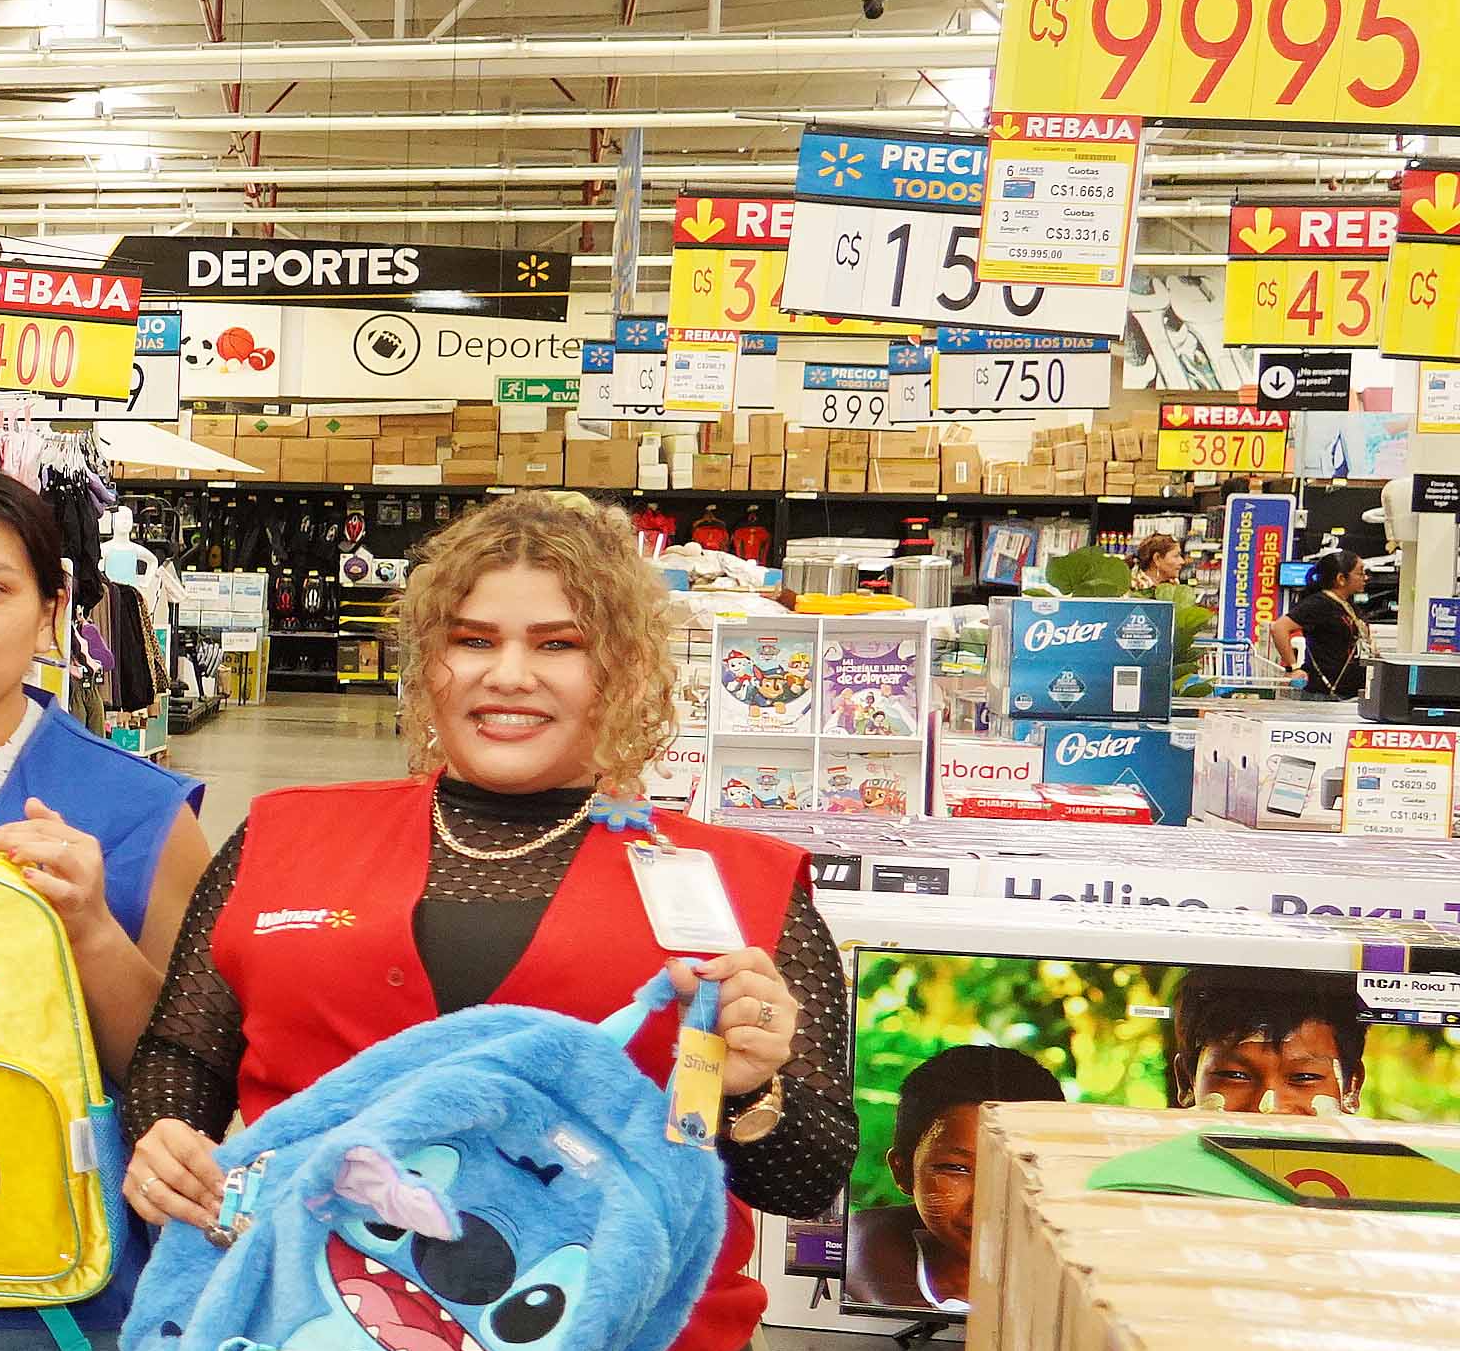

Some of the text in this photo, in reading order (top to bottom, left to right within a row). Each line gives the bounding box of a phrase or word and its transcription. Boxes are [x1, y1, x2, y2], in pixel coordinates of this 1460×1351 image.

[1025, 116, 1135, 140] REBAJA
[836, 232, 862, 271] C$
[187, 249, 420, 288] DEPORTES
[437, 328, 580, 366] Deporte
[684, 330, 736, 342] REBAJA
[986, 338, 1031, 349] TODOS
[831, 368, 878, 379] PRECIO
[976, 358, 1065, 404] C$ 750
[822, 394, 884, 426] 899
[1193, 406, 1284, 427] REBAJA
[1192, 434, 1265, 468] 3870
[1235, 511, 1254, 607] precios bajos
[1257, 531, 1278, 595] rebajas
[1024, 620, 1108, 652] Oster
[1056, 732, 1140, 765] Oster
[1271, 730, 1332, 744] EPSON
[1371, 732, 1452, 749] REBAJA
[257, 909, 328, 927] Walmart
